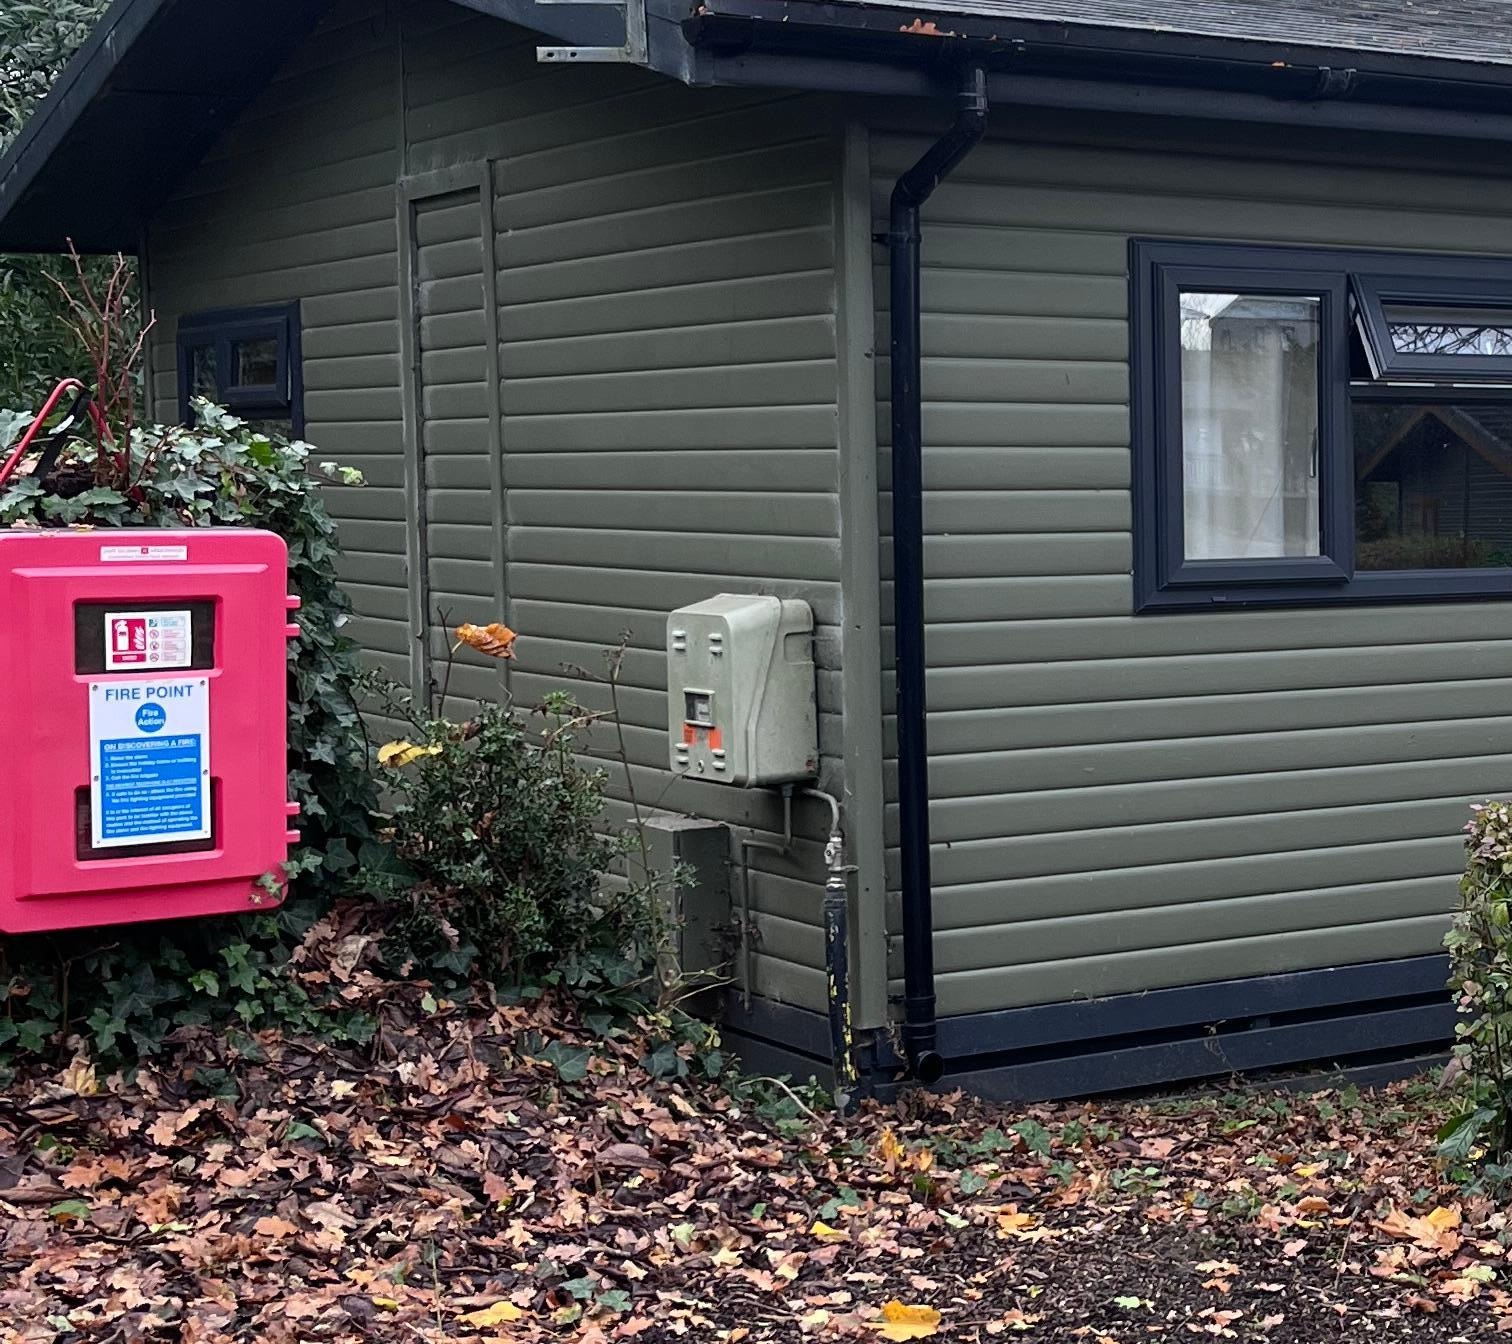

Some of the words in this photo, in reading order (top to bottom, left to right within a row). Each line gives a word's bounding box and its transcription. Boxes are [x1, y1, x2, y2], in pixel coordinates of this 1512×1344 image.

[105, 687, 141, 701] FIRE
[146, 685, 194, 699] POINT
[142, 709, 159, 717] Fire
[137, 717, 165, 726] Action
